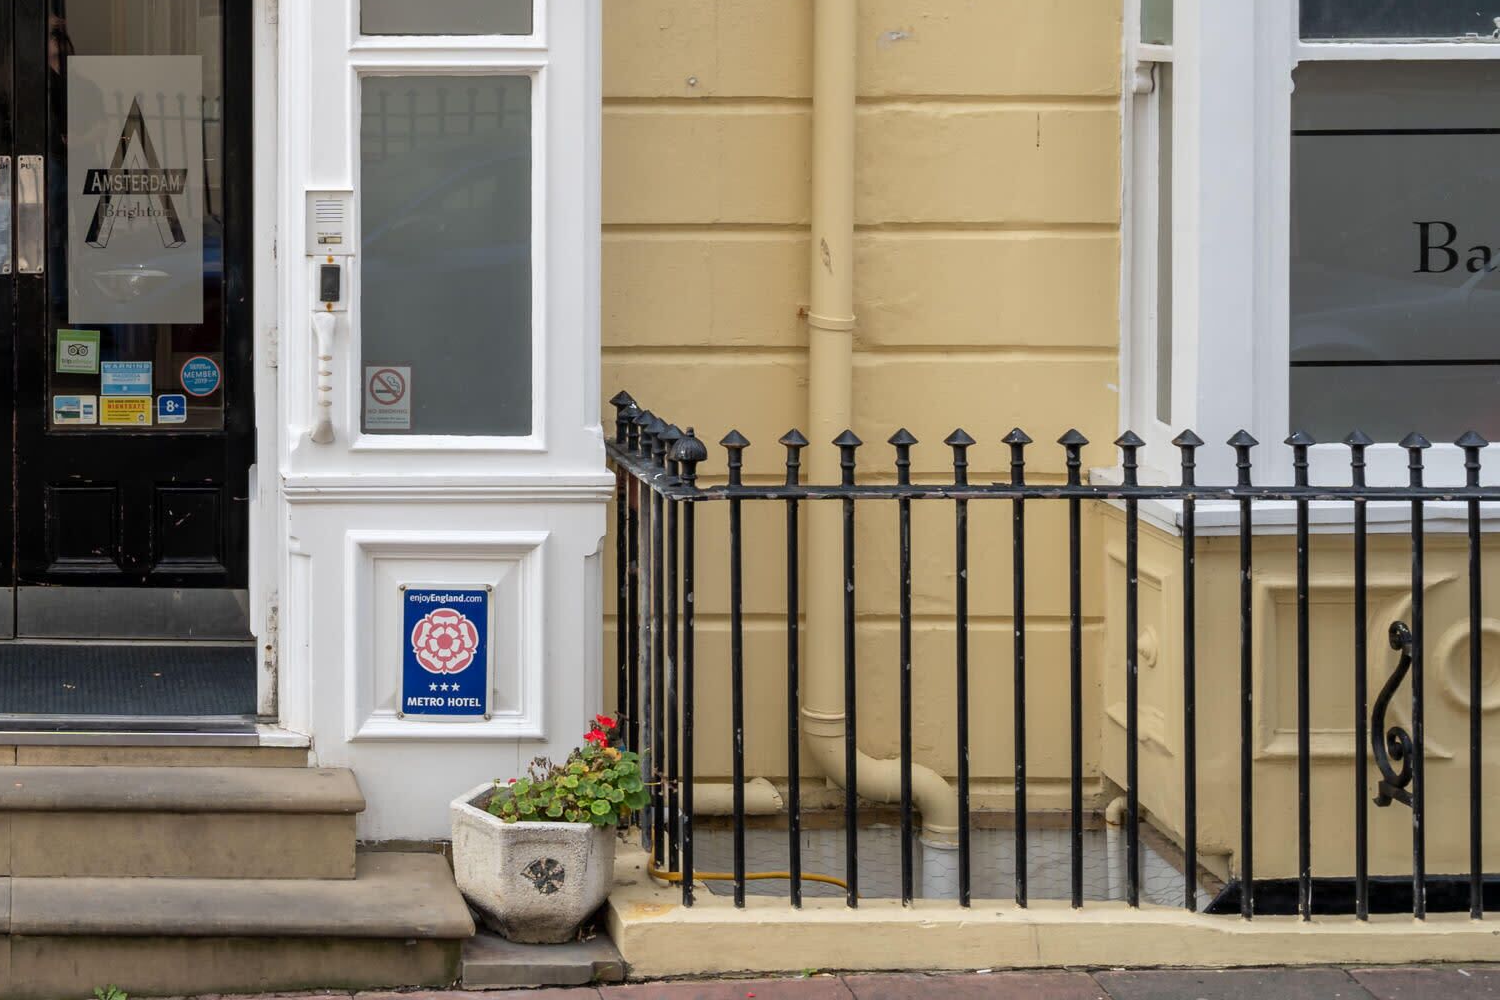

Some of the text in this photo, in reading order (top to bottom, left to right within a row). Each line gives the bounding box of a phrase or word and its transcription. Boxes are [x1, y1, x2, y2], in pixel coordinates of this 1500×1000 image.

[91, 171, 180, 193] AMSTERDAM
[1412, 221, 1500, 274] Ba
[183, 370, 218, 379] MEMBER
[409, 593, 483, 604] enjoyEngland.com
[407, 696, 482, 707] METRO HOTEL
